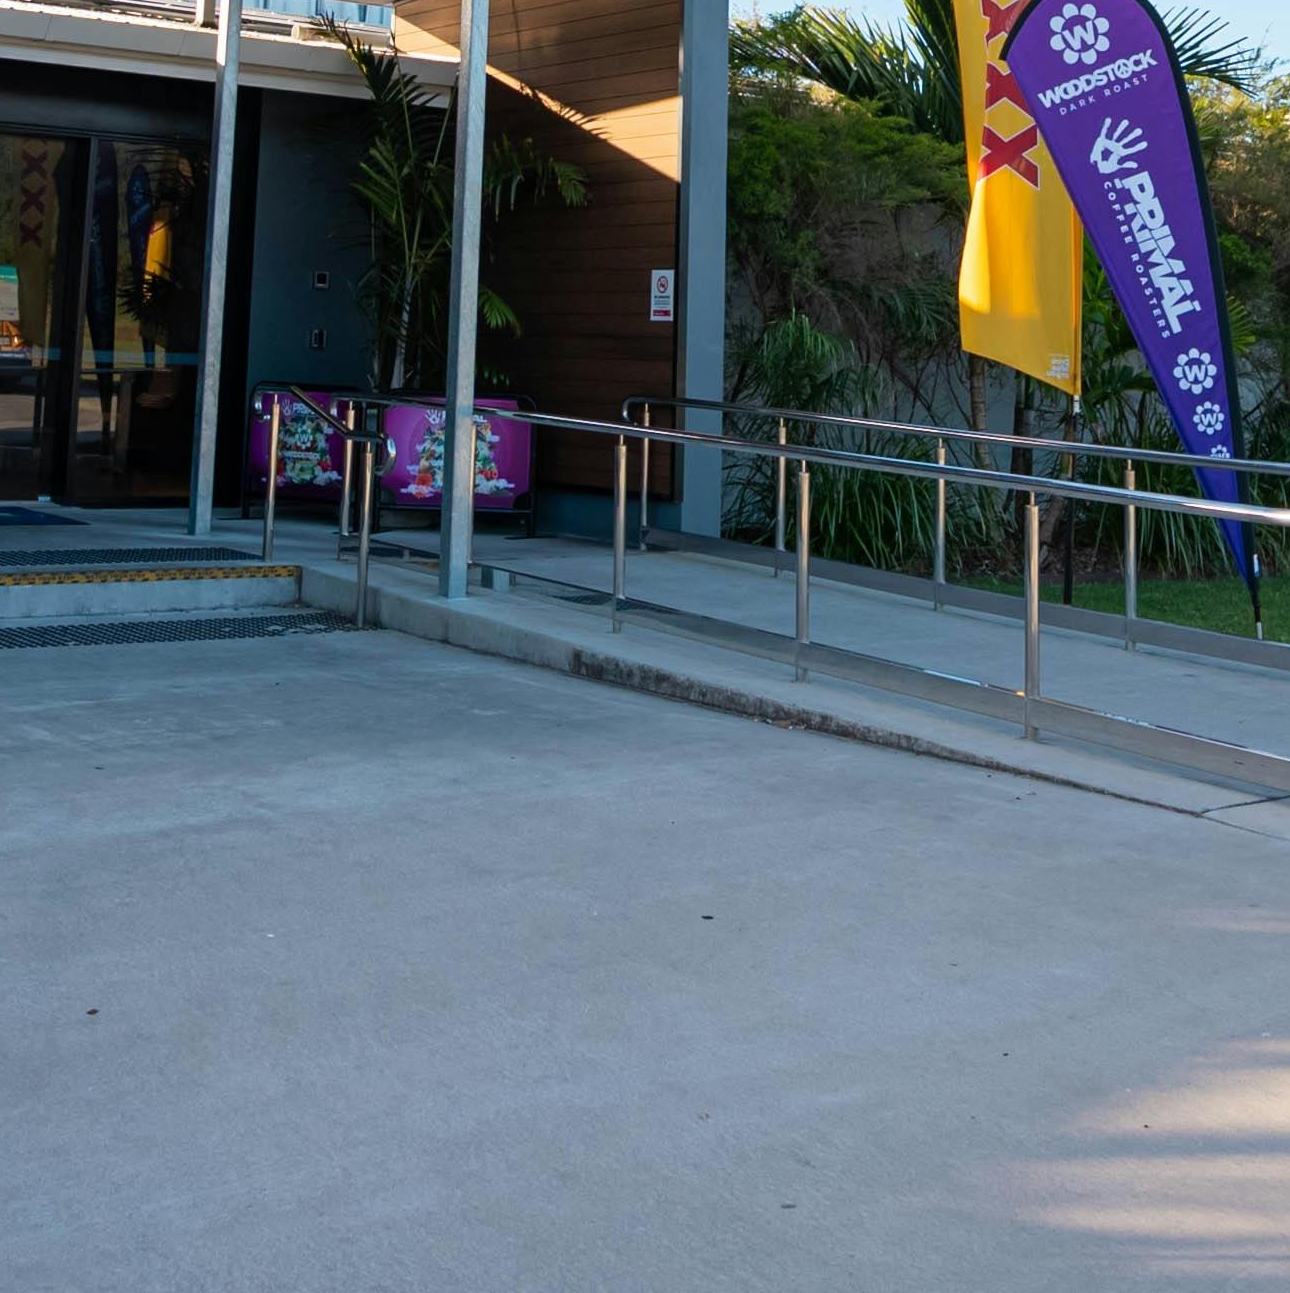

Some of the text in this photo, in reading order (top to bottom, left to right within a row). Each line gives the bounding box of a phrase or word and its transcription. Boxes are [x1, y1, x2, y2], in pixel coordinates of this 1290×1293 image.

[1062, 20, 1095, 51] W
[1037, 49, 1158, 109] WOODSTOCK
[1059, 74, 1147, 115] DARK ROAST
[1104, 181, 1170, 339] COFFEE ROASTERS
[1114, 171, 1201, 334] PRIMAL
[1184, 365, 1207, 382] W
[1201, 413, 1217, 426] W
